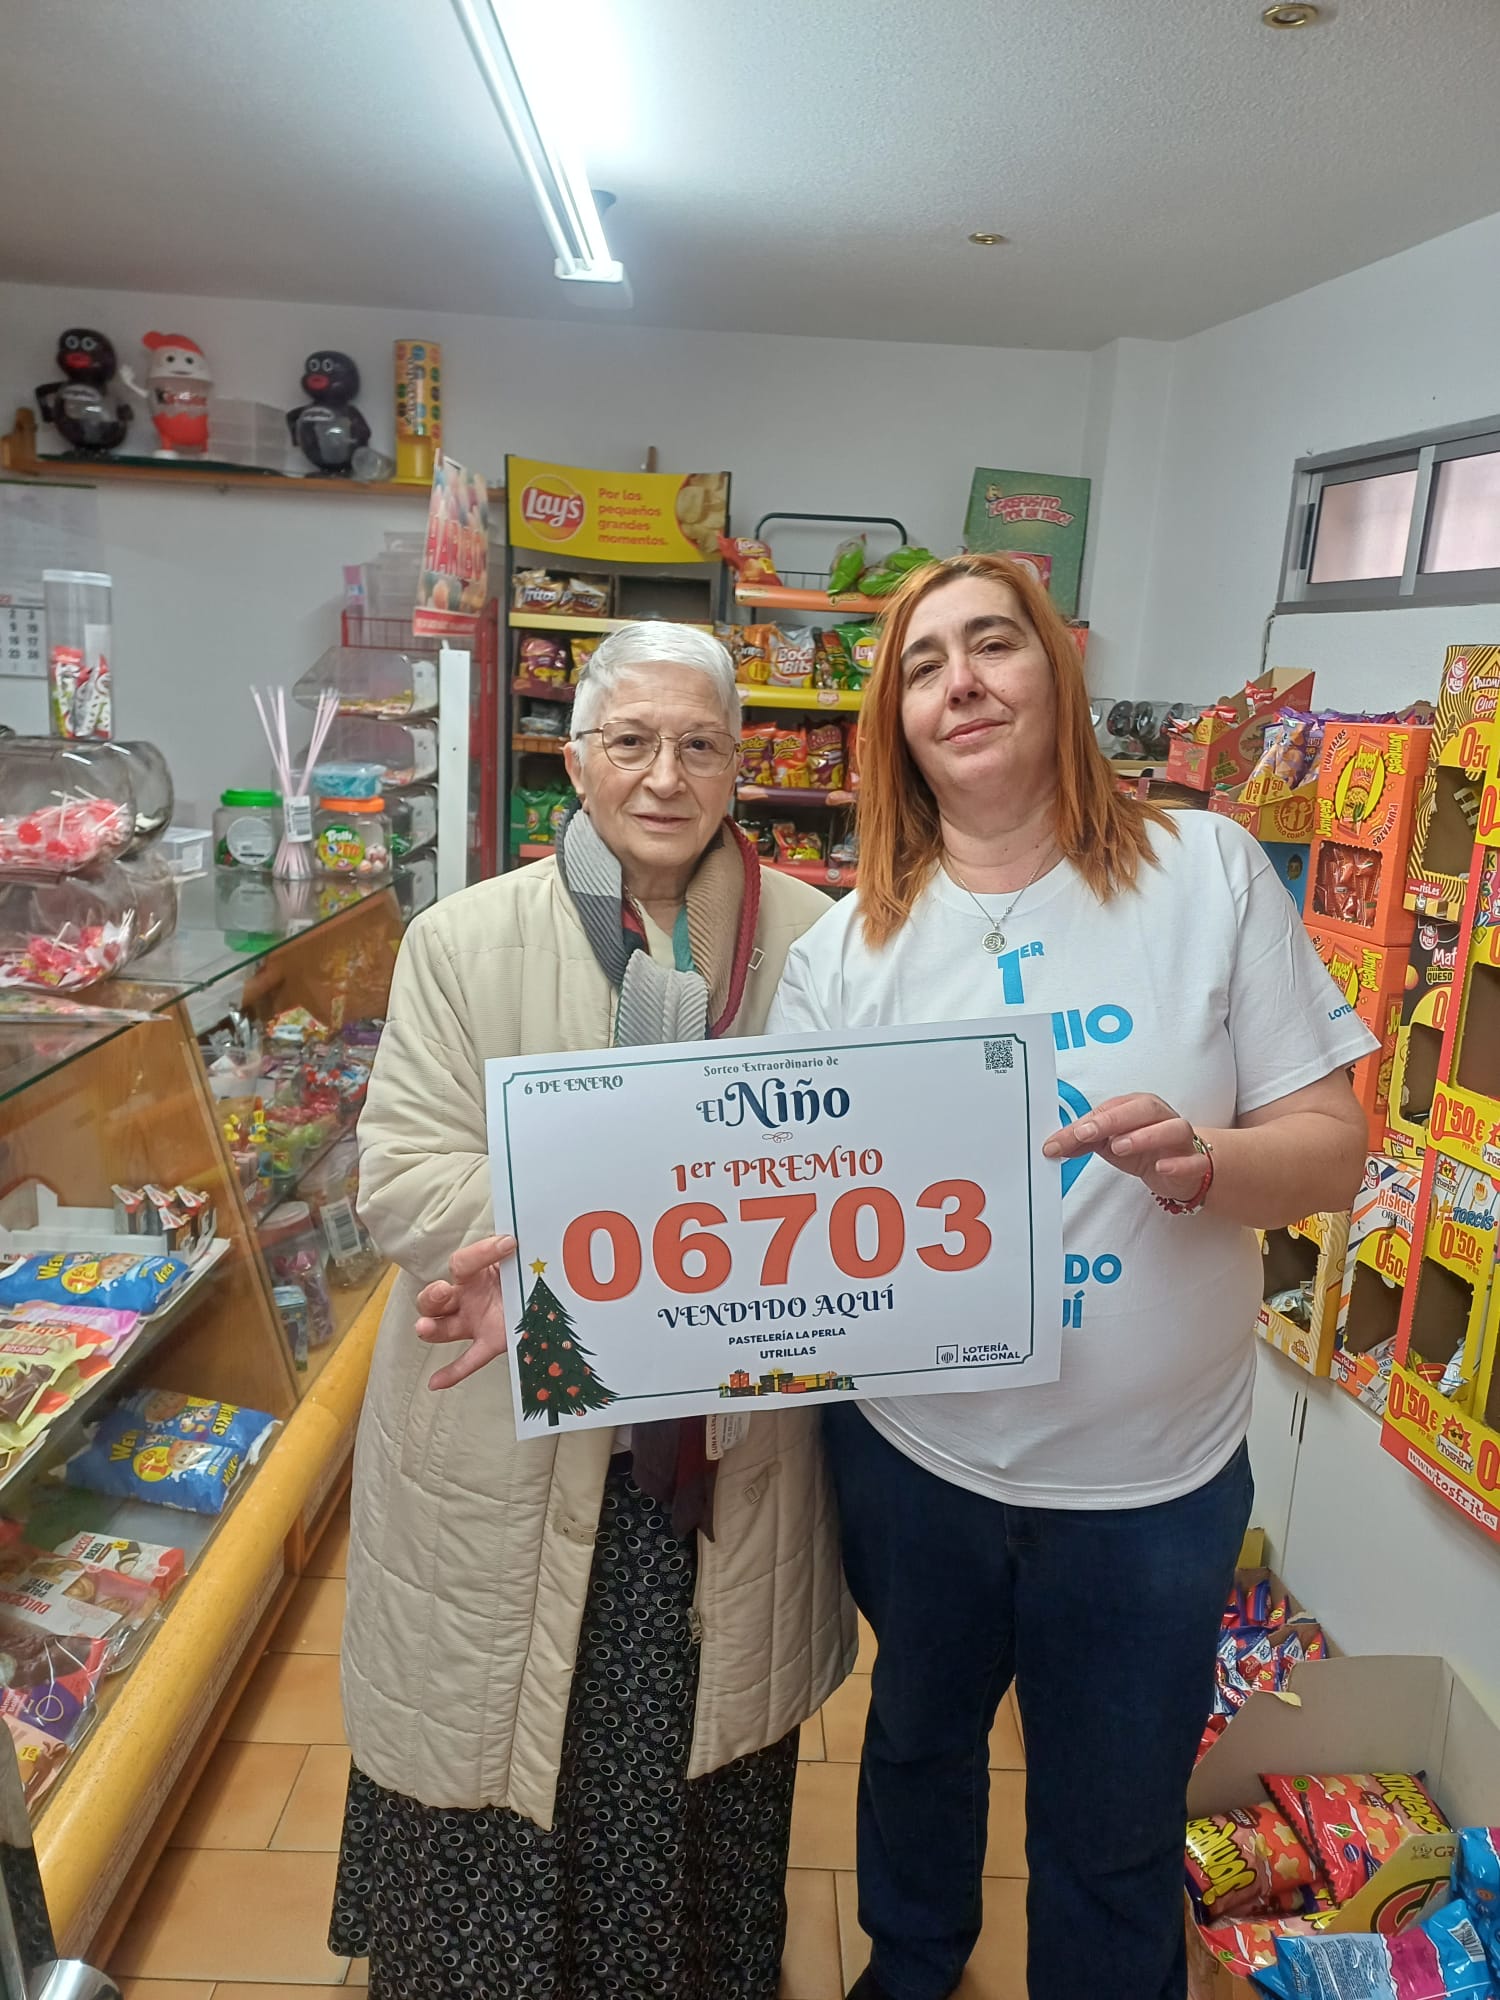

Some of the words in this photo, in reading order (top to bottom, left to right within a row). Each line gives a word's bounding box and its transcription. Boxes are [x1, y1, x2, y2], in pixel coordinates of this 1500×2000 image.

[598, 487, 620, 500] Por
[623, 489, 641, 501] los
[525, 487, 581, 528] Lay's
[598, 503, 662, 518] pequeños
[598, 519, 651, 531] grandes
[778, 647, 813, 663] Boca
[780, 660, 813, 675] Bits
[1426, 970, 1454, 984] QUESO
[704, 1064, 739, 1077] Sorteo
[741, 1056, 823, 1074] Extraordinario
[826, 1055, 840, 1067] de
[524, 1083, 533, 1095] 6
[536, 1080, 562, 1094] DE
[564, 1074, 624, 1091] ENERO
[695, 1098, 725, 1124] El
[724, 1077, 851, 1129] Niño
[670, 1159, 716, 1193] 1er
[723, 1145, 884, 1189] PREMIO
[562, 1178, 993, 1303] 06703
[657, 1295, 807, 1329] VENDIDO
[811, 1283, 895, 1321] AQUÍ
[728, 1330, 794, 1346] PASTELERÍA
[796, 1331, 810, 1340] LA
[811, 1327, 847, 1338] PERLA
[760, 1346, 817, 1359] UTRILLAS
[962, 1342, 1009, 1354] LOTERÍA
[962, 1351, 1021, 1363] NACIONAL
[1440, 1443, 1470, 1472] TOSFRIT
